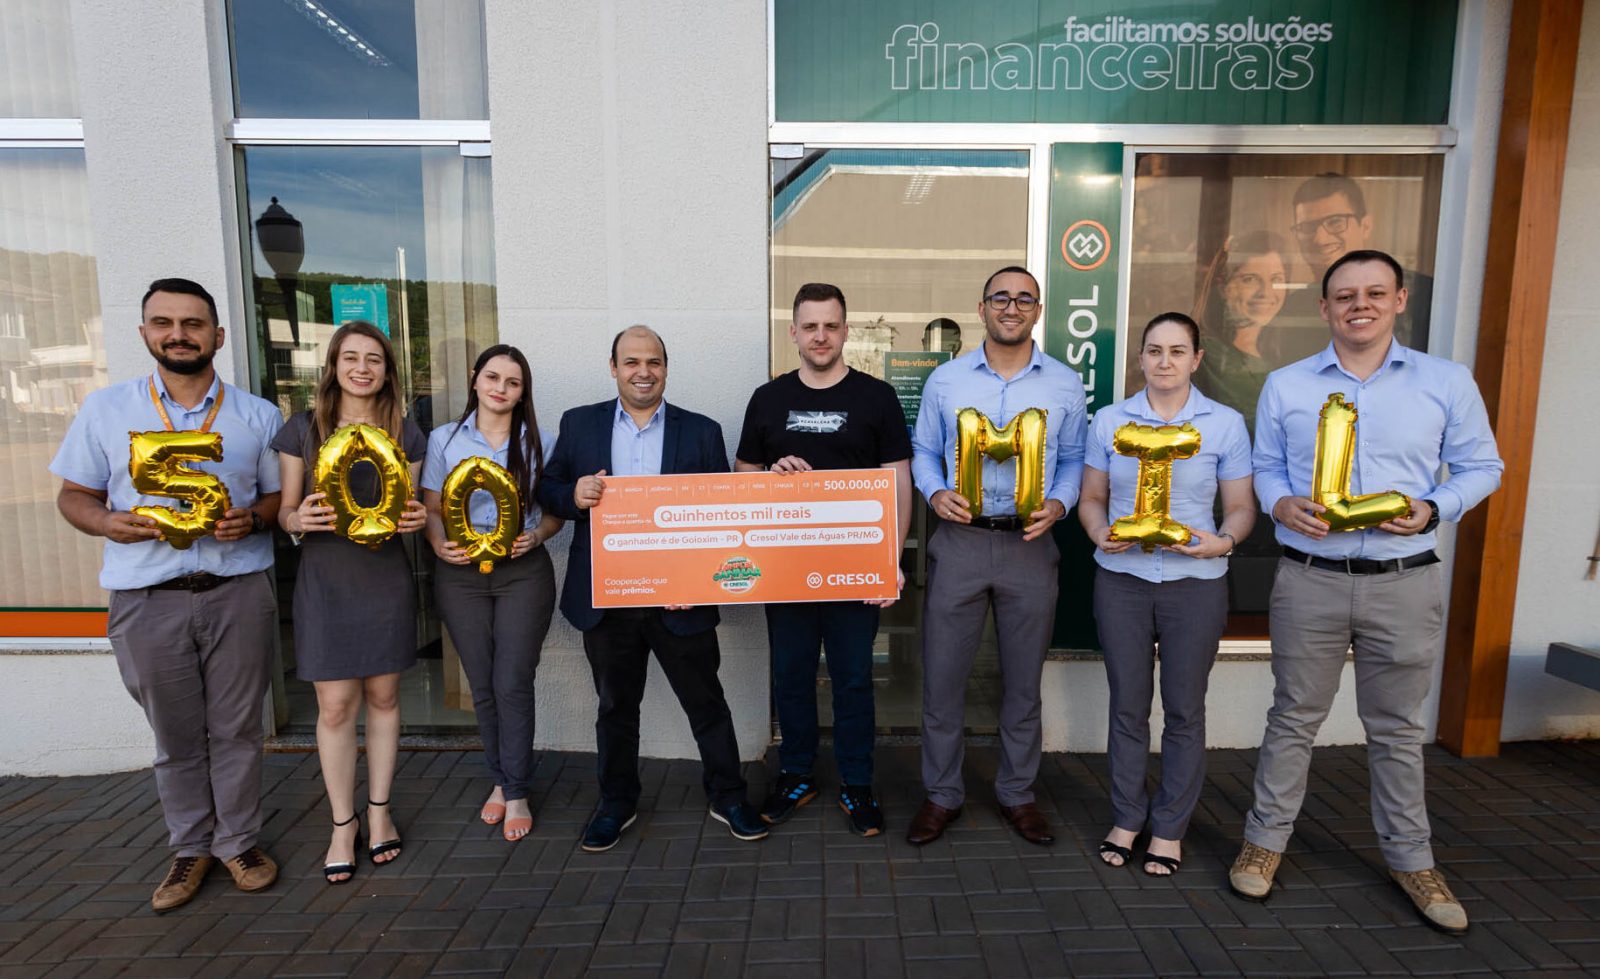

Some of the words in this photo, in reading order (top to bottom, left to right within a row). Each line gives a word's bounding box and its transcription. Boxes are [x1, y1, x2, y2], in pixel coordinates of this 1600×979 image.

[1064, 15, 1209, 43] facilitamos
[1214, 15, 1333, 49] soluções
[885, 22, 1315, 91] financeiras
[1065, 285, 1100, 425] ESOL
[823, 479, 889, 491] 500.000,00
[660, 508, 747, 523] Quinhentos
[751, 507, 773, 520] mil
[776, 506, 812, 519] reais
[607, 538, 615, 546] O
[617, 537, 658, 547] ganhador
[660, 536, 667, 545] é
[668, 536, 680, 545] de
[681, 535, 718, 544] Goioxim
[726, 535, 738, 543] PR
[750, 533, 777, 542] Cresol
[779, 533, 799, 541] Vale
[801, 531, 816, 541] das
[818, 530, 845, 542] Águas
[847, 530, 879, 539] PR/MG
[604, 577, 651, 587] Cooperação
[652, 578, 668, 587] que
[827, 573, 884, 586] CRESOL
[622, 586, 656, 596] prêmios.
